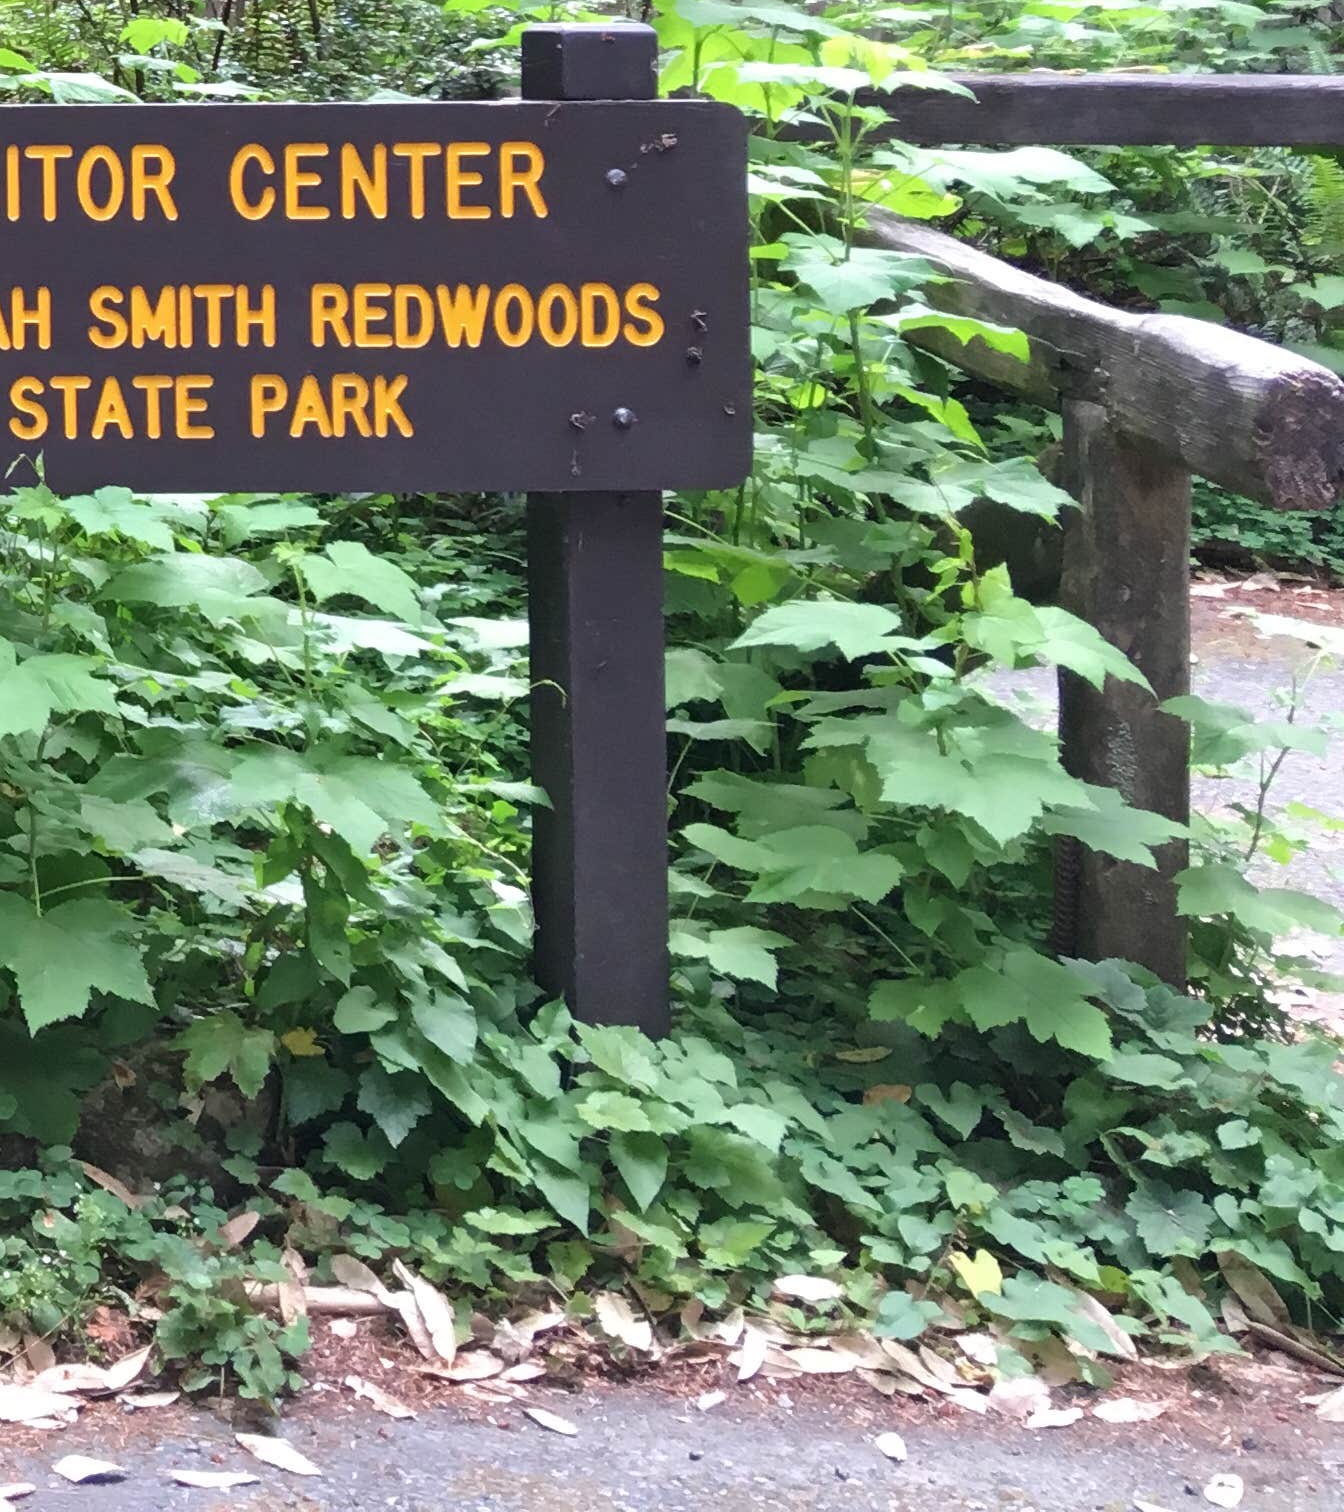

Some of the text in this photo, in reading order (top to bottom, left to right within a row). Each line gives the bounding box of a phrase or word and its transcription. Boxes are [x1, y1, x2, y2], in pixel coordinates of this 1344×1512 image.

[229, 141, 548, 220] CENTER
[88, 283, 277, 348] SMITH
[310, 282, 666, 347] REDWOODS
[9, 373, 415, 439] STATE PARK
